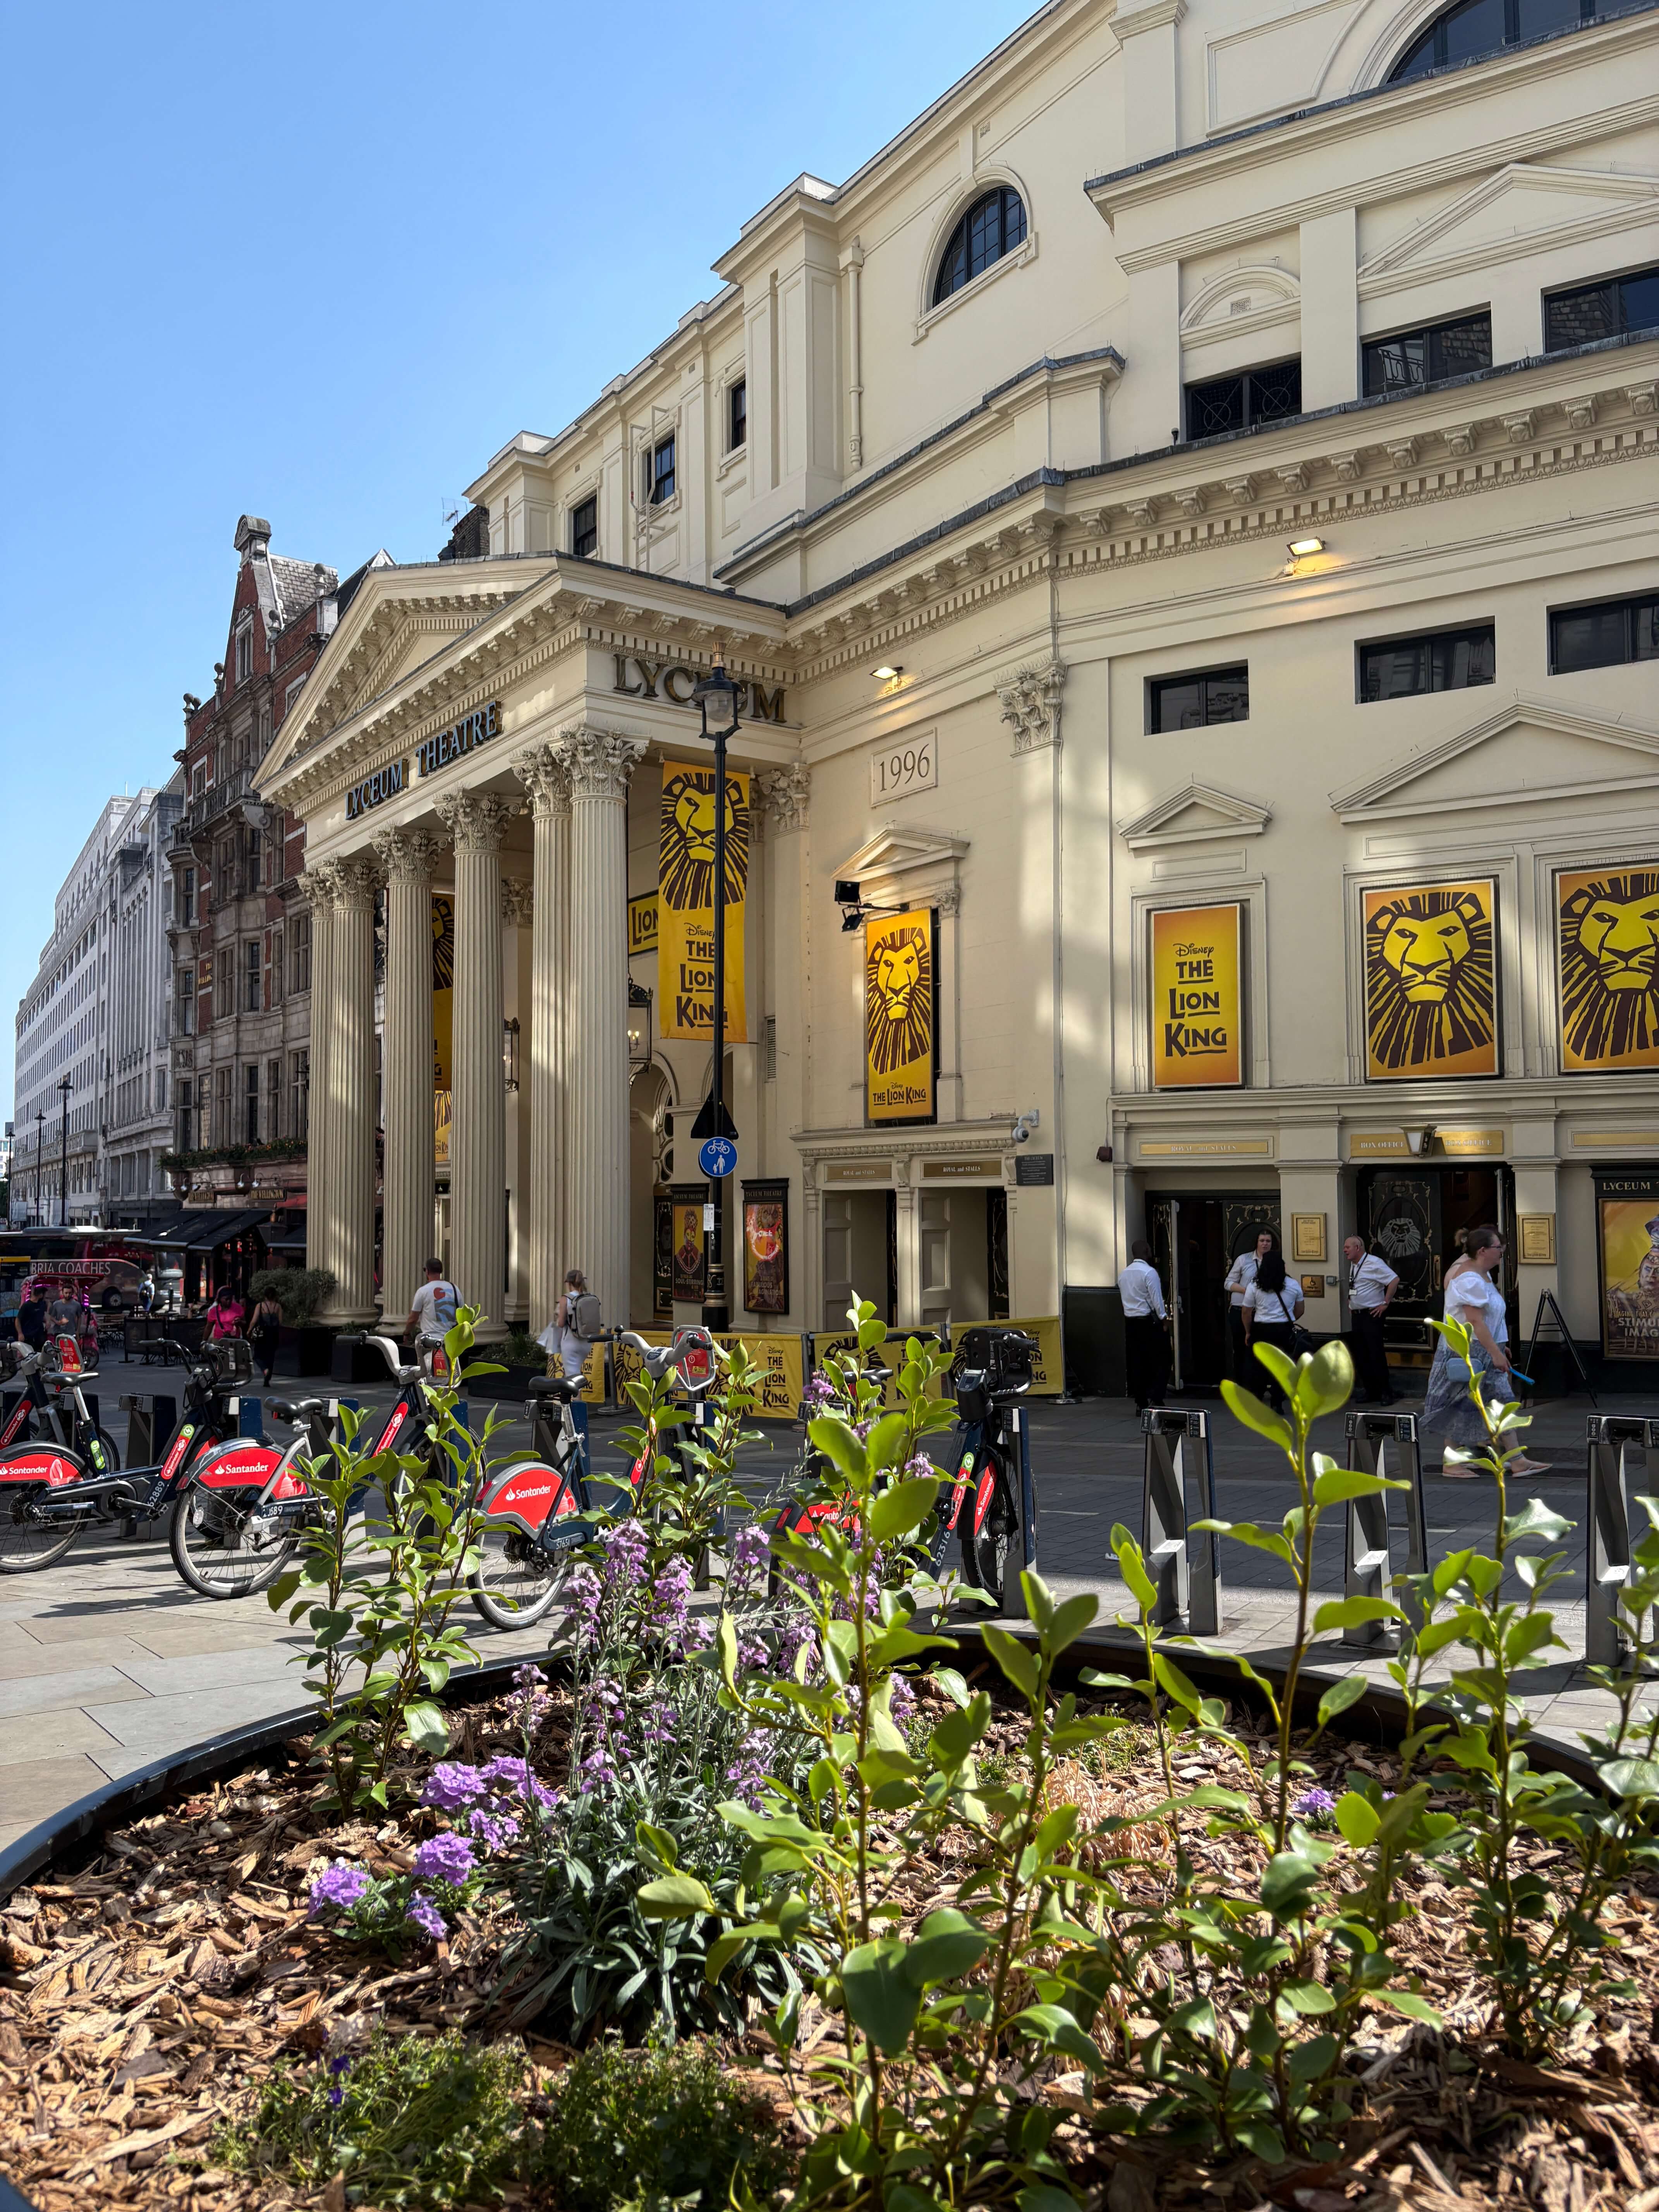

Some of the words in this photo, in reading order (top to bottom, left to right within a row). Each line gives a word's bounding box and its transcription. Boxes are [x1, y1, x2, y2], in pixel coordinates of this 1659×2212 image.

[613, 653, 787, 723] LYCM
[345, 759, 408, 820] LYCEUM
[415, 701, 501, 777] THEATRE
[879, 744, 930, 792] 1996
[1173, 943, 1214, 958] Disney
[1176, 959, 1213, 979] THE
[1169, 988, 1219, 1020] LION
[1165, 1022, 1227, 1057] KING
[873, 1092, 886, 1103] THE
[887, 1088, 904, 1106] LION
[905, 1086, 926, 1104] KING
[1602, 1182, 1650, 1190] LYCEUM
[259, 1189, 283, 1199] WELLINGTON
[58, 1262, 111, 1274] COACHES
[583, 1362, 593, 1372] ION
[767, 1356, 783, 1366] THE
[765, 1374, 786, 1388] LION
[763, 1389, 789, 1408] KING
[9, 1466, 48, 1475] Santander
[225, 1462, 269, 1474] Santander
[516, 1485, 551, 1499] Santander
[935, 1531, 950, 1567] 62316
